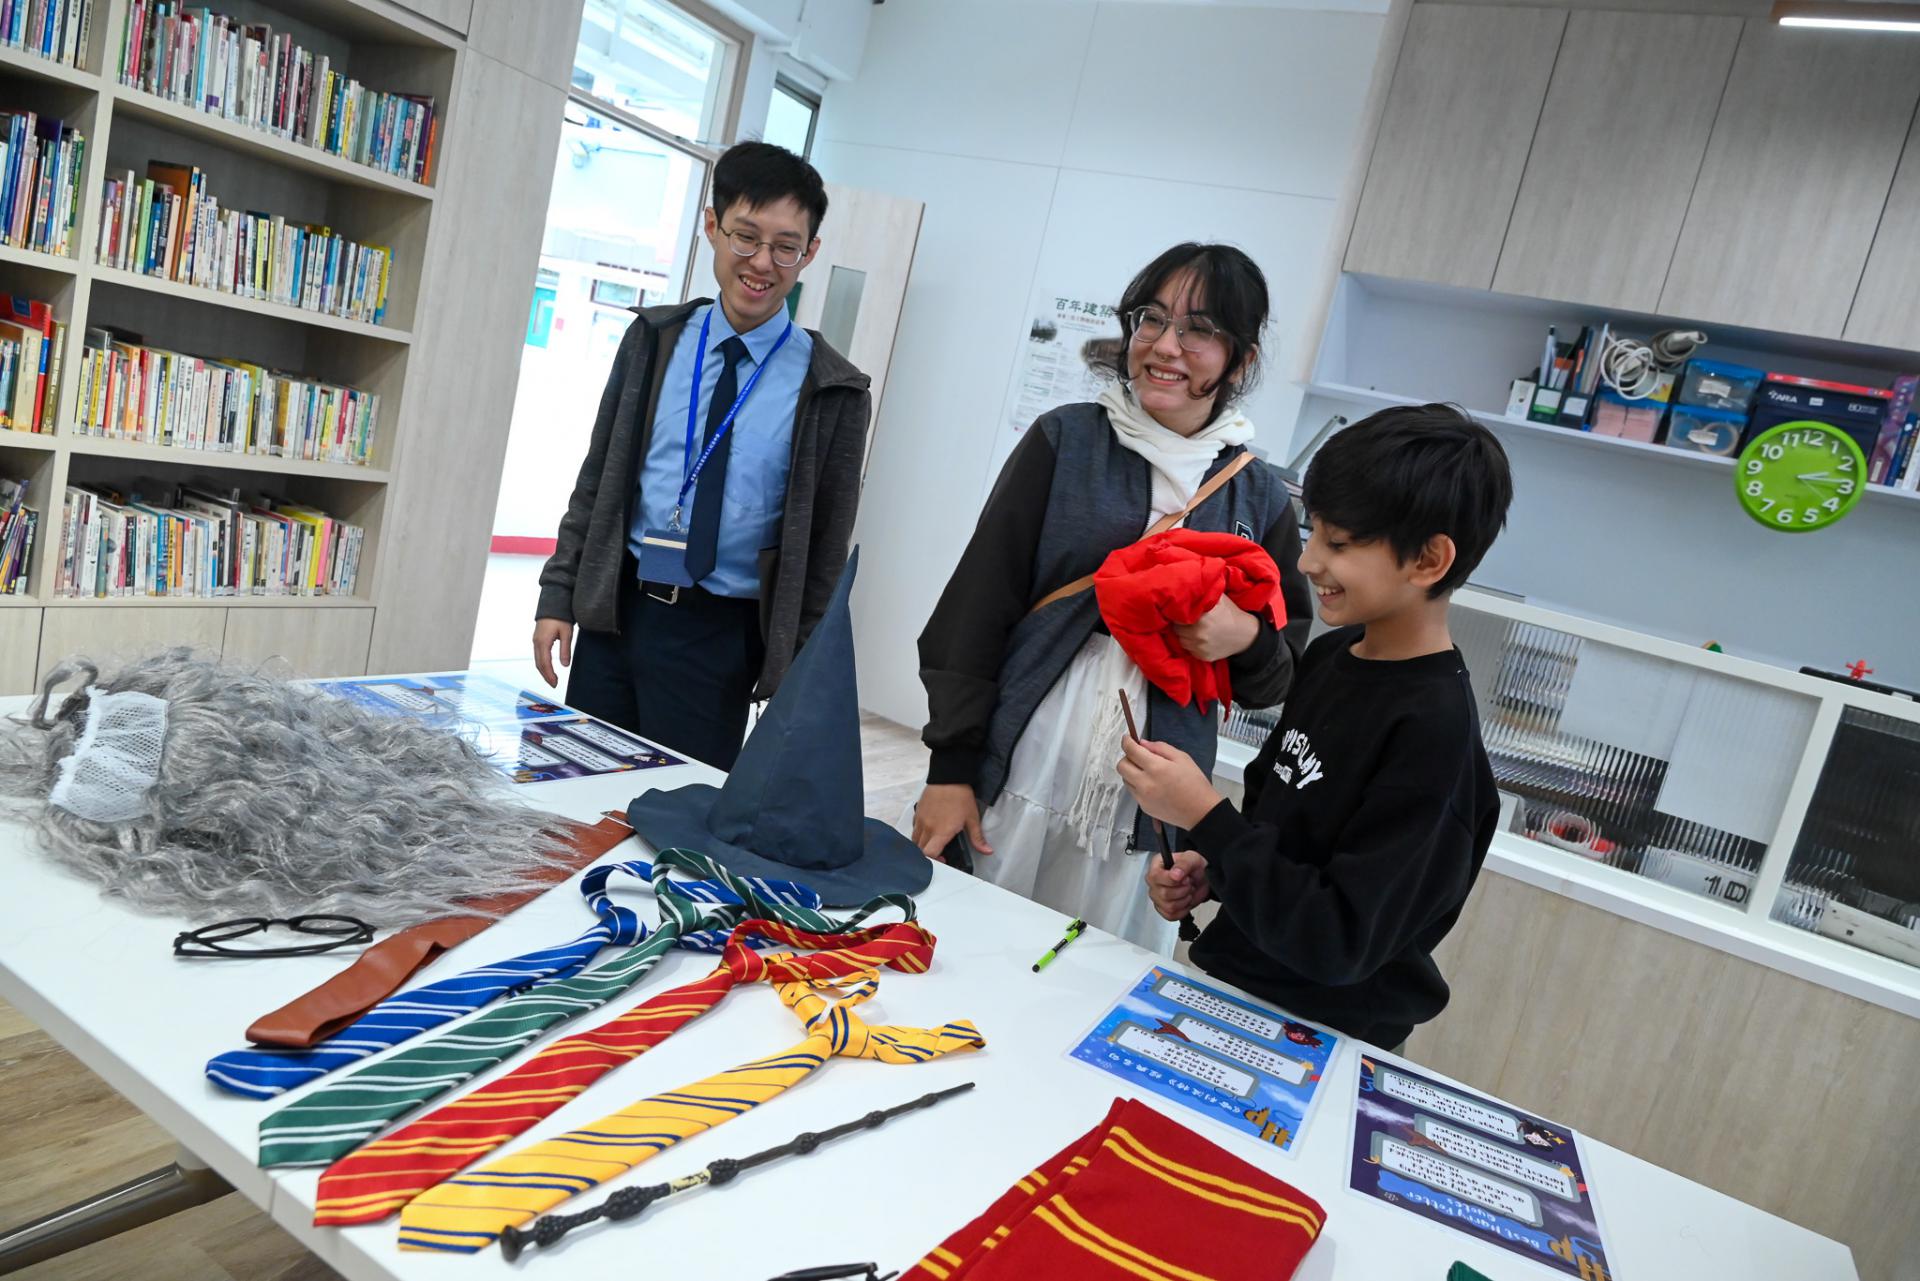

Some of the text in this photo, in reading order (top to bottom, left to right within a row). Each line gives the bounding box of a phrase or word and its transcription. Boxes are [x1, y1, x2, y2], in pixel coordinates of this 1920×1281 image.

[1782, 432, 1800, 448] 11
[1803, 429, 1825, 446] 12
[1761, 443, 1784, 460] 10
[1831, 441, 1839, 455] 1
[1746, 460, 1763, 475] 9
[1837, 456, 1854, 471] 2
[1746, 480, 1763, 496] 8
[1836, 479, 1854, 494] 3
[1760, 498, 1776, 512] 7
[1822, 497, 1839, 512] 4
[1777, 508, 1794, 523] 6
[1802, 508, 1819, 523] 5
[1456, 1207, 1501, 1235] Harry
